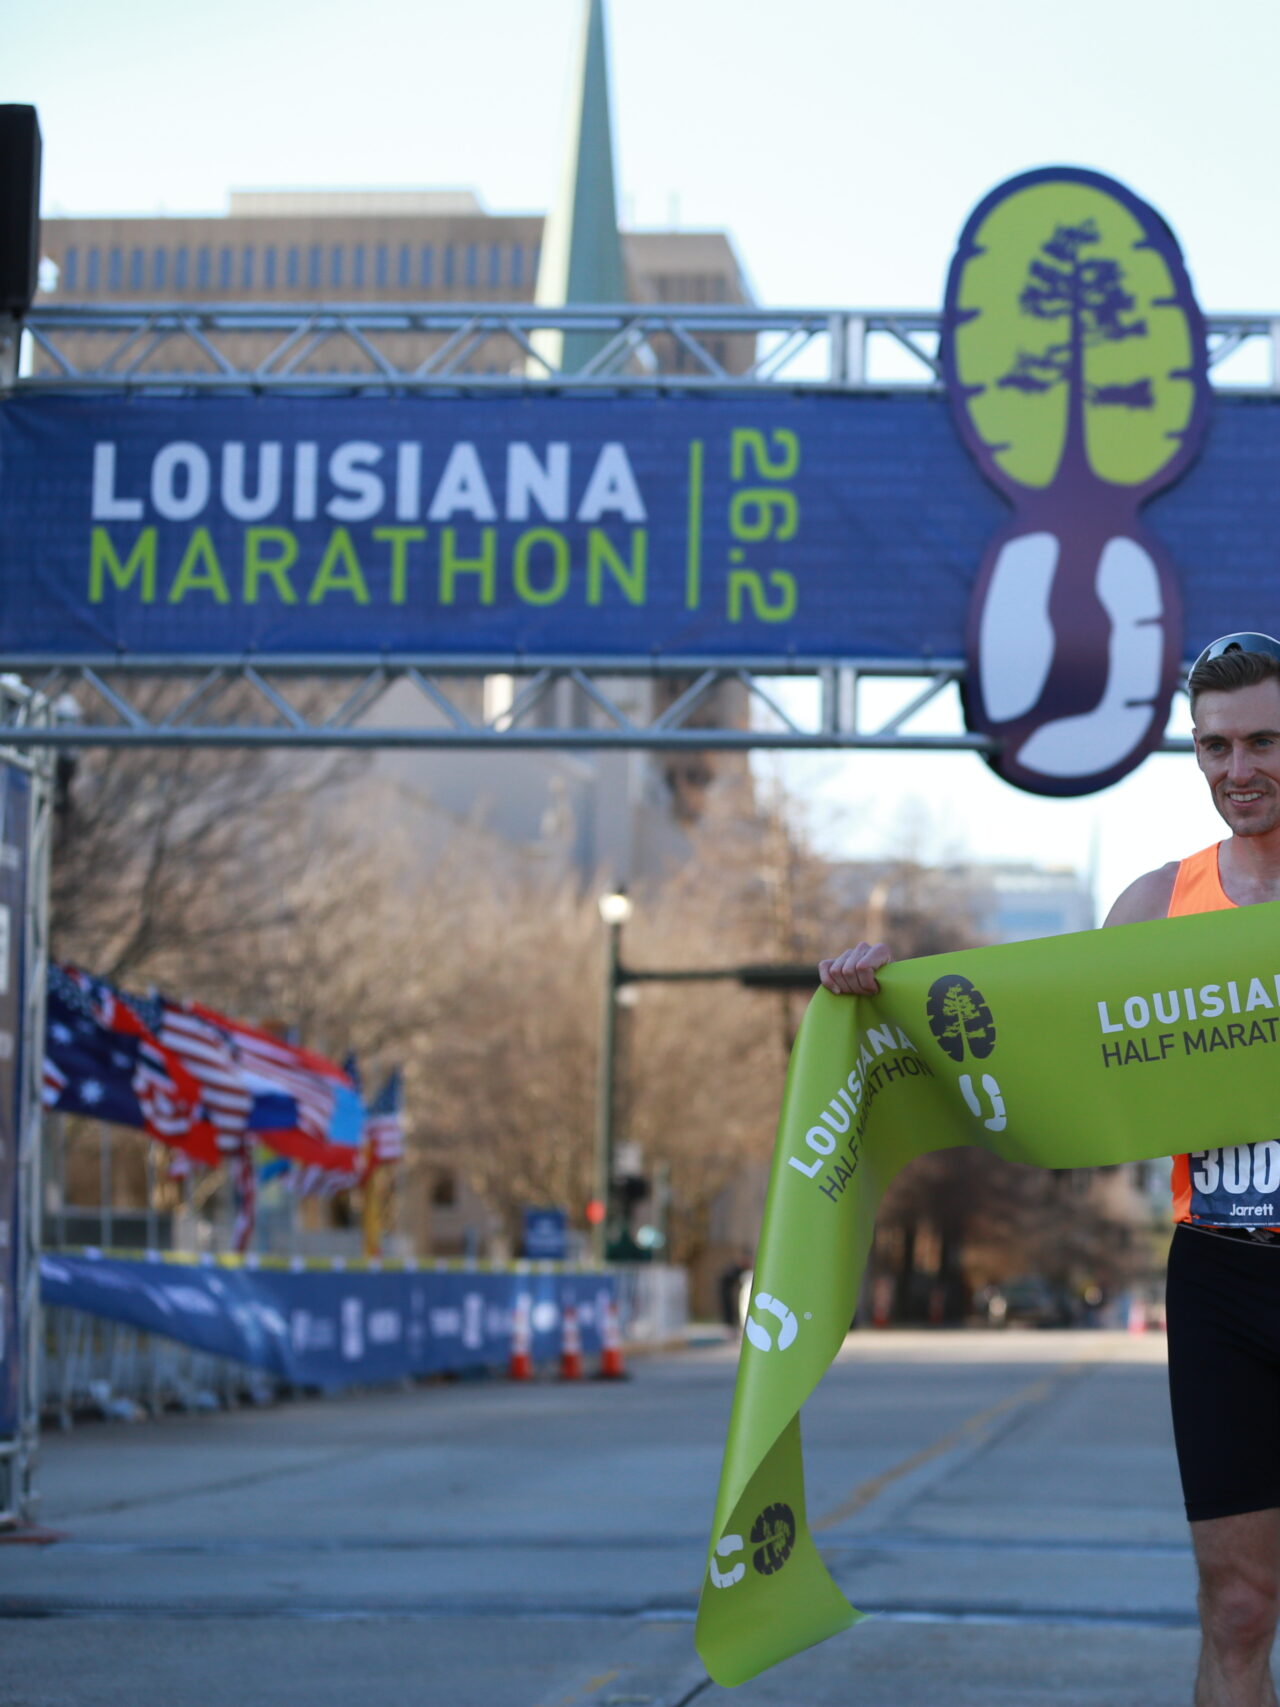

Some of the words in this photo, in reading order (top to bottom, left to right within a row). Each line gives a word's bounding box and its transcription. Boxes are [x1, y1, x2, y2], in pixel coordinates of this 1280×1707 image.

[92, 441, 648, 521] LOUISIANA
[728, 428, 798, 623] 26.2
[89, 527, 647, 605] MARATHON
[1101, 1033, 1175, 1068] HALF
[788, 1023, 918, 1178] LOUISIANA
[819, 1135, 860, 1202] HALF
[1229, 1203, 1274, 1217] Jarrett
